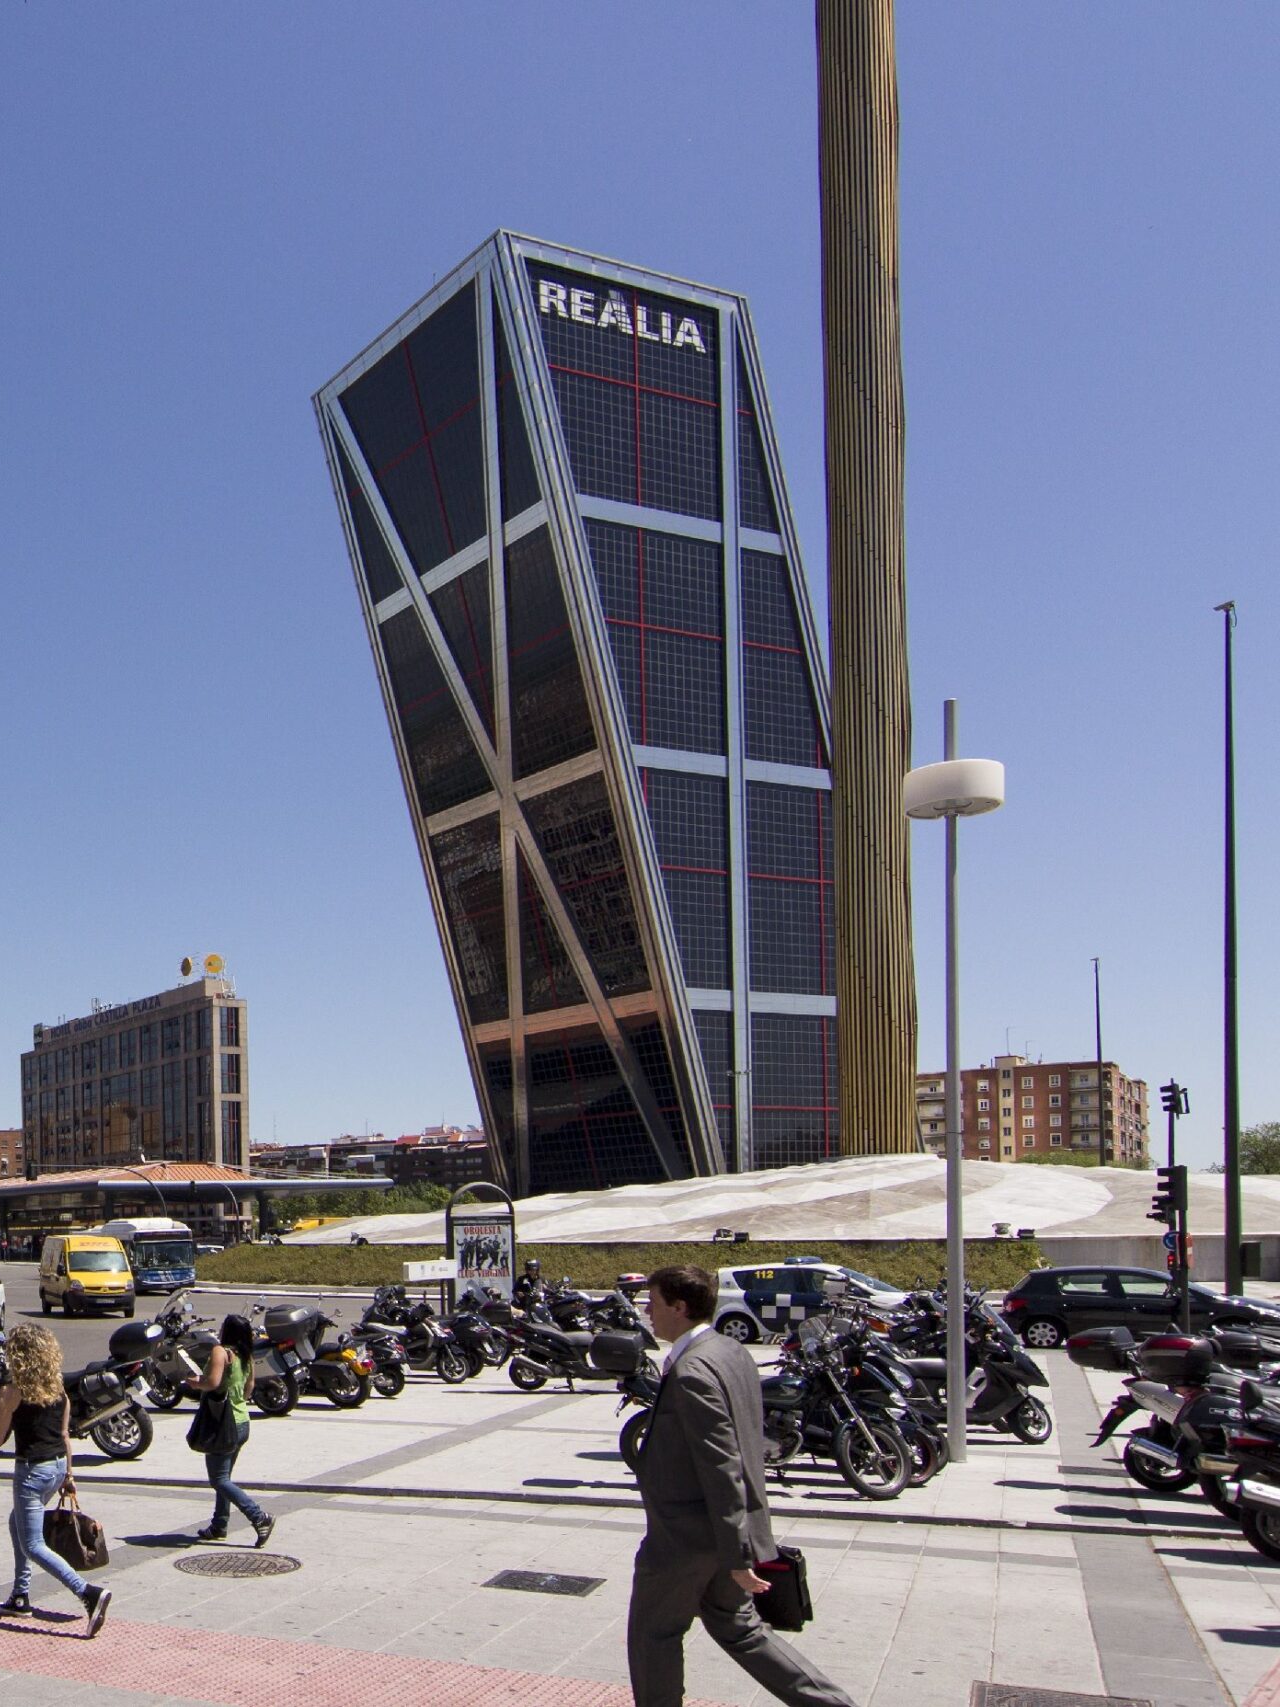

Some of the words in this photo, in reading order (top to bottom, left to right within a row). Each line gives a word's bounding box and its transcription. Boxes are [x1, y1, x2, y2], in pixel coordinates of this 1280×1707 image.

[539, 279, 707, 354] REALIA
[51, 1023, 71, 1039] HOTEL
[74, 1017, 93, 1032] abba
[95, 1004, 128, 1026] CASTILLA
[133, 995, 161, 1013] PLAZA
[464, 1226, 502, 1235] ORQUESTA
[478, 1268, 510, 1277] VIRGINIA
[754, 1270, 774, 1279] 112
